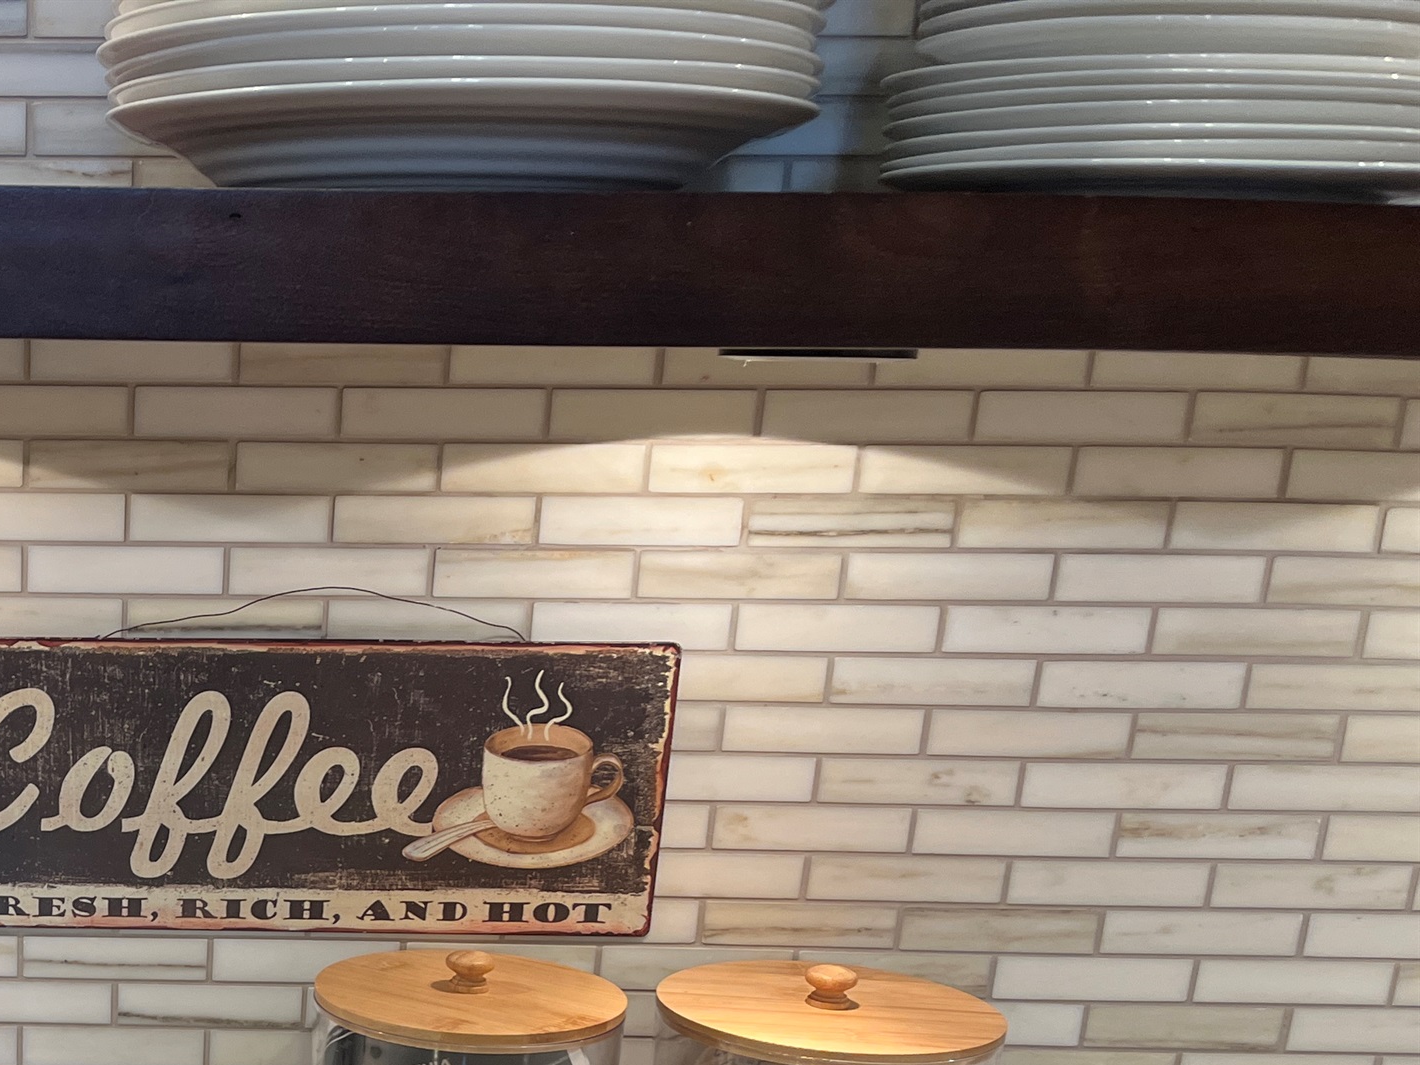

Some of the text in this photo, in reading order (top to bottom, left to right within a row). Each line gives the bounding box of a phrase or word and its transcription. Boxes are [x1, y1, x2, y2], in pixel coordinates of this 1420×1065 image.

[175, 894, 341, 924] RICH,
[356, 899, 468, 921] AND
[482, 900, 611, 923] HOT
